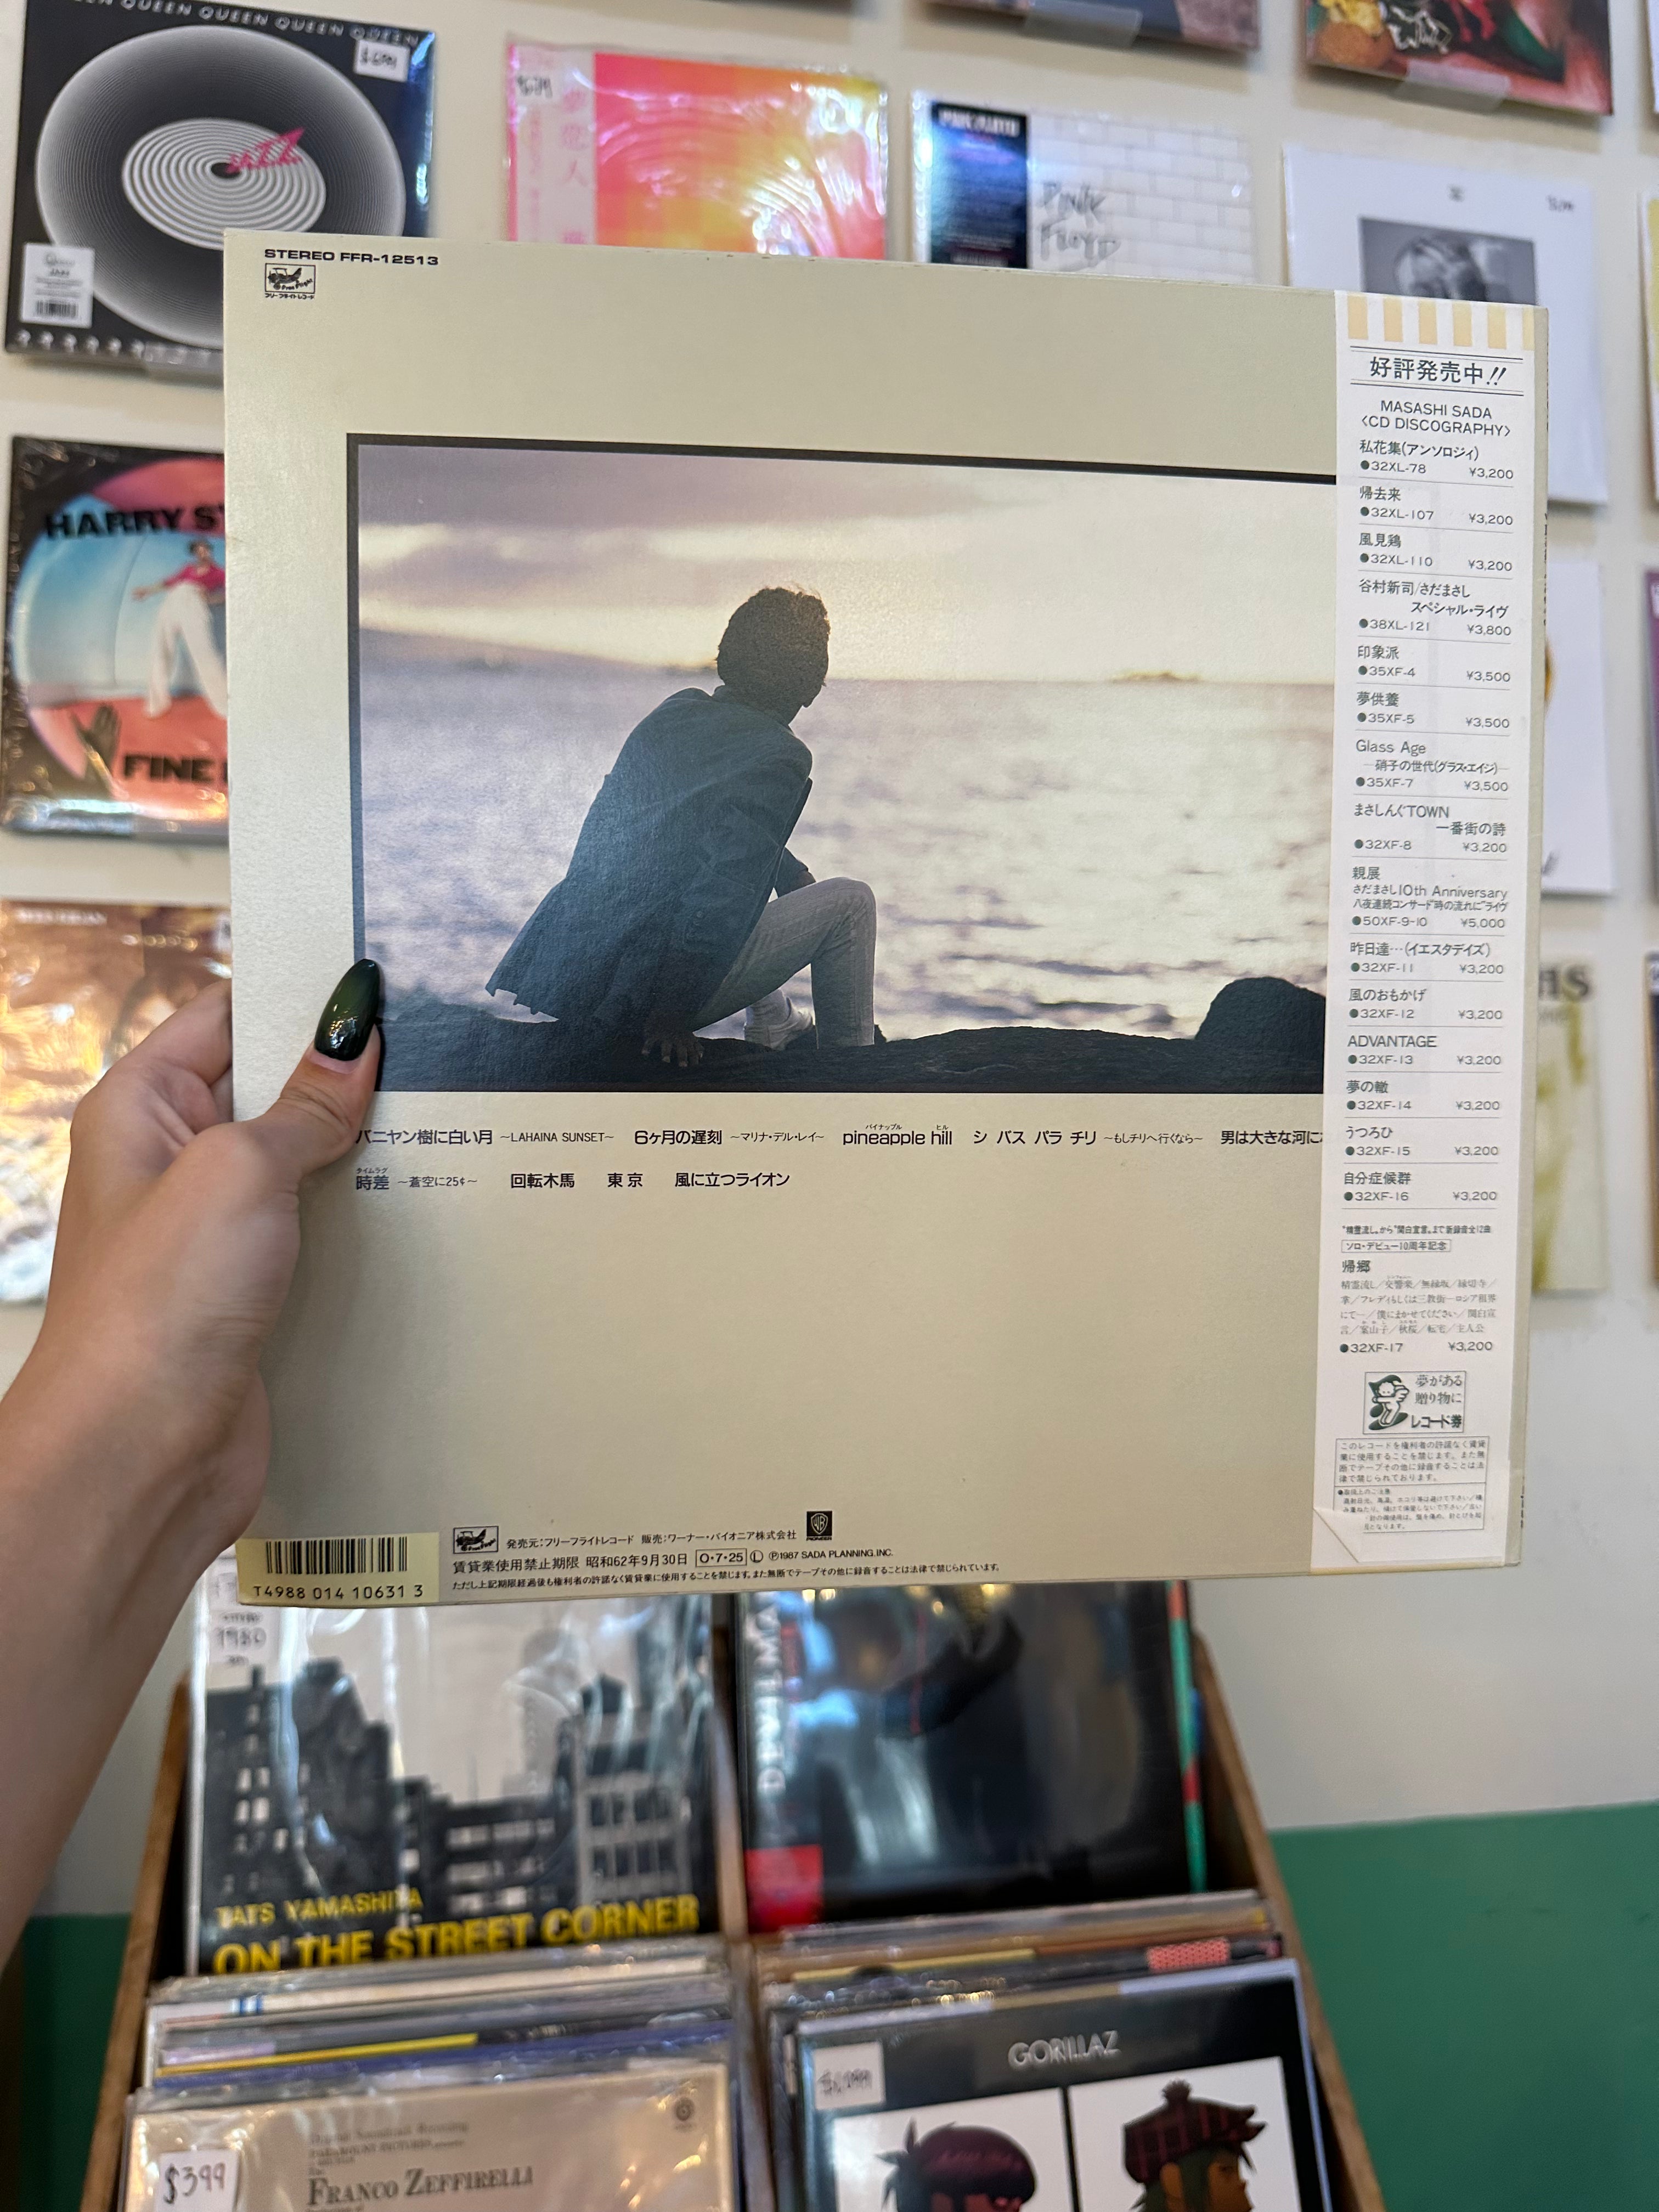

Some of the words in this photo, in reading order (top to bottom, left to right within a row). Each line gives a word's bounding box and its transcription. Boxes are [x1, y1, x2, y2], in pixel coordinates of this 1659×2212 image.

[264, 249, 335, 262] STEREO
[340, 252, 439, 266] FFR-12513
[1380, 400, 1447, 416] MASASHI
[1452, 405, 1492, 419] SADA
[1371, 460, 1427, 474] 32XL-78
[1469, 466, 1514, 480] ¥3,200
[1359, 486, 1402, 502] 帰去来
[45, 506, 183, 541] HARRY
[1371, 506, 1435, 521] 32XL-107
[1468, 513, 1514, 526] ¥3,200
[1358, 532, 1402, 548] 風見鶏
[1370, 553, 1433, 567] 32XL-110
[1468, 559, 1513, 572] ¥3,200
[1369, 619, 1430, 632] 38XL-121
[1466, 623, 1511, 636] ¥3,800
[1357, 645, 1400, 661] 印象派
[1369, 665, 1416, 678] 35XF-4
[1466, 670, 1511, 683] ¥3,500
[1356, 691, 1400, 707] 夢供養
[1368, 712, 1415, 725] 35XF-5
[1465, 716, 1510, 729] ¥3,500
[1356, 739, 1394, 754] Glass
[1400, 741, 1426, 757] Age
[124, 754, 216, 784] FINE
[1366, 776, 1414, 789] 35XF-7
[1464, 780, 1509, 792] ¥3,500
[1436, 821, 1506, 837] 一番街の詩
[1364, 839, 1412, 851] 32XF-8
[1462, 842, 1507, 853] ¥3,200
[1351, 866, 1380, 881] 親展
[1431, 885, 1508, 901] Anniversary
[1460, 918, 1505, 928] ¥5,000
[1361, 962, 1414, 973] 32XF-11
[1459, 964, 1504, 975] ¥3,200
[1348, 987, 1426, 1003] 風のおもかげ
[1360, 1008, 1415, 1019] 32XF-12
[1458, 1009, 1503, 1020] ¥3,200
[1347, 1035, 1438, 1048] ADVANTAGE
[1358, 1054, 1414, 1065] 32XF-13
[1457, 1054, 1502, 1066] ¥3,200
[1357, 1099, 1412, 1111] 32XF-14
[1455, 1099, 1500, 1111] ¥3,200
[355, 1129, 493, 1145] バニヤン樹に白い月
[843, 1130, 926, 1146] pineapple
[931, 1130, 953, 1146] hill
[973, 1130, 988, 1145] シ
[996, 1130, 1026, 1145] バス
[1034, 1130, 1063, 1145] パラ
[1070, 1130, 1097, 1146] チリ
[1220, 1130, 1324, 1146] 男は大きな河に
[1345, 1125, 1394, 1141] うつろひ
[1356, 1146, 1411, 1156] 32XF-15
[1454, 1145, 1499, 1156] ¥3,200
[356, 1175, 390, 1191] 時差
[510, 1173, 575, 1189] 回転木馬
[674, 1172, 791, 1188] 風に立つライオン
[1343, 1171, 1412, 1186] 自分症候群
[1355, 1190, 1409, 1201] 32XF-16
[1452, 1190, 1497, 1201] ¥3,200
[1342, 1259, 1371, 1274] 帰郷
[1350, 1342, 1403, 1353] 32XF-17
[1447, 1341, 1493, 1352] ¥3,200
[1415, 1374, 1463, 1388] 夢がある
[1414, 1391, 1462, 1406] 贈り物に
[1410, 1414, 1463, 1429] レコード券
[453, 1556, 580, 1575] 賃貸業使用禁止期限
[586, 1553, 688, 1568] 昭和62年9月30日
[802, 1550, 826, 1559] SADA
[253, 1585, 306, 1599] T4988
[313, 1585, 345, 1600] 014
[352, 1585, 405, 1599] 10631
[414, 1584, 424, 1598] 3
[215, 1901, 275, 1931] TATS
[213, 1941, 281, 1976] ON
[294, 1929, 374, 1970] THE
[385, 1911, 534, 1962] STREET
[541, 1893, 700, 1946] CORNER
[1007, 2029, 1121, 2070] GORILLAZ
[163, 2162, 226, 2205] $399
[307, 2176, 400, 2206] FRANCO
[403, 2164, 534, 2198] ZEFFIRELLI
